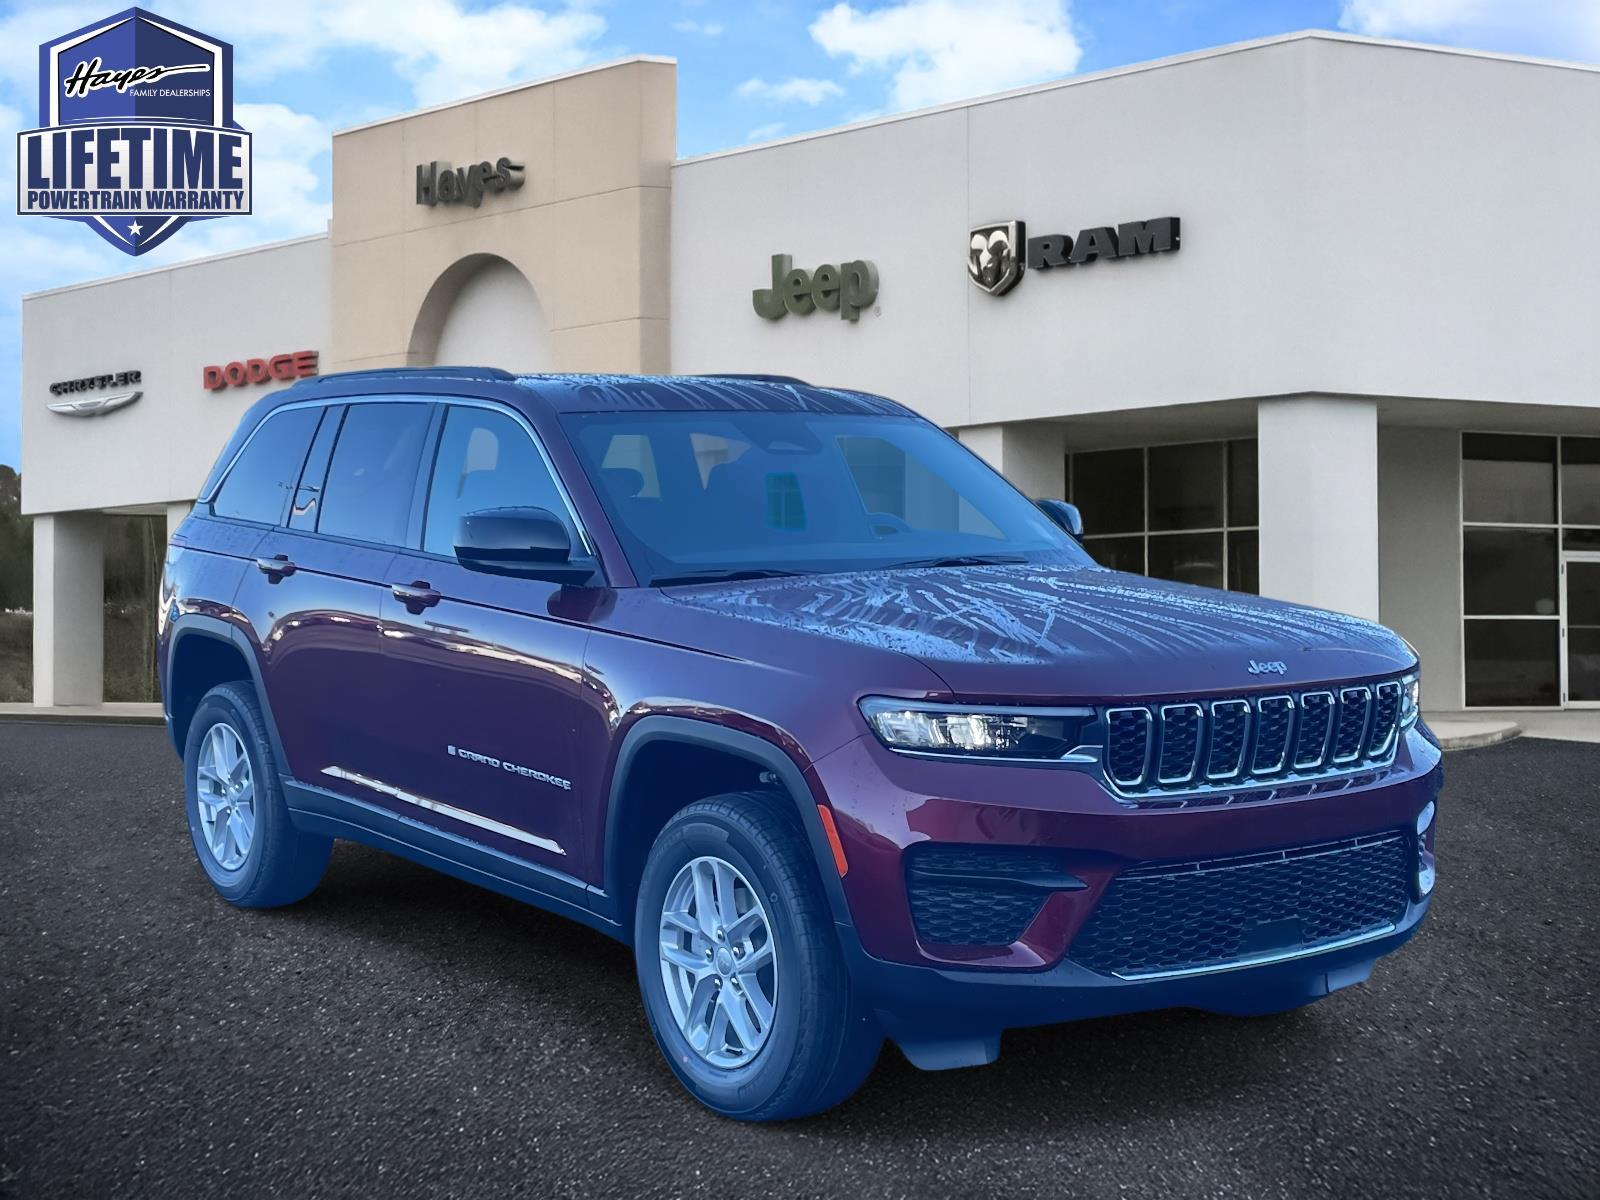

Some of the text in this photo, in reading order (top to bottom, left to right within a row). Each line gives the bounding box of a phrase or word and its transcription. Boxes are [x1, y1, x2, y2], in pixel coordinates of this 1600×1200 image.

[416, 157, 525, 209] Hayes
[1028, 217, 1180, 270] RAM
[752, 253, 879, 323] Jeep
[203, 350, 319, 391] DODGE
[1247, 660, 1287, 675] Jeep
[458, 748, 572, 790] GRAND CHEROKEE
